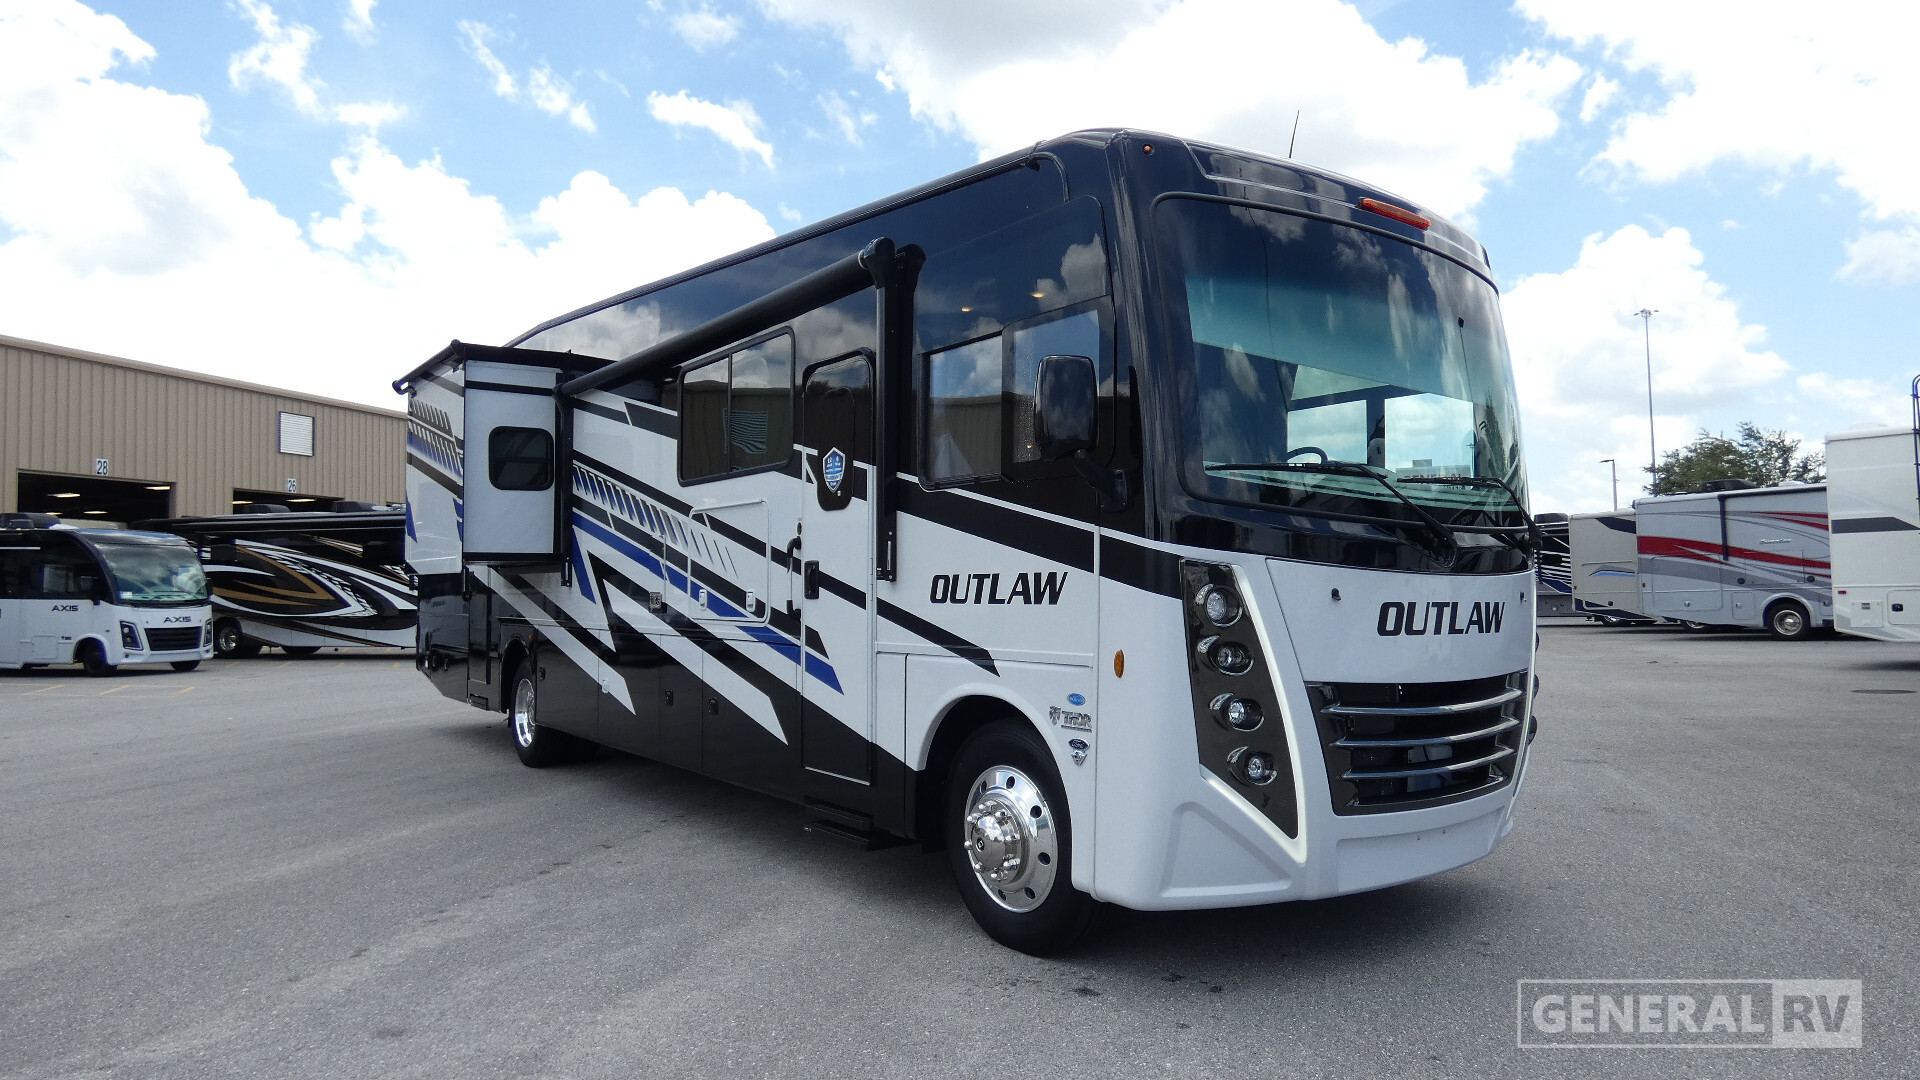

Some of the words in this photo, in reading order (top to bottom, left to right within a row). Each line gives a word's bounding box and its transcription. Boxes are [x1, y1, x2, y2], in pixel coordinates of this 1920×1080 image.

[97, 460, 108, 475] 28
[930, 571, 1069, 605] OUTLAW
[1377, 601, 1505, 637] OUTLAW
[1061, 710, 1092, 728] THOR
